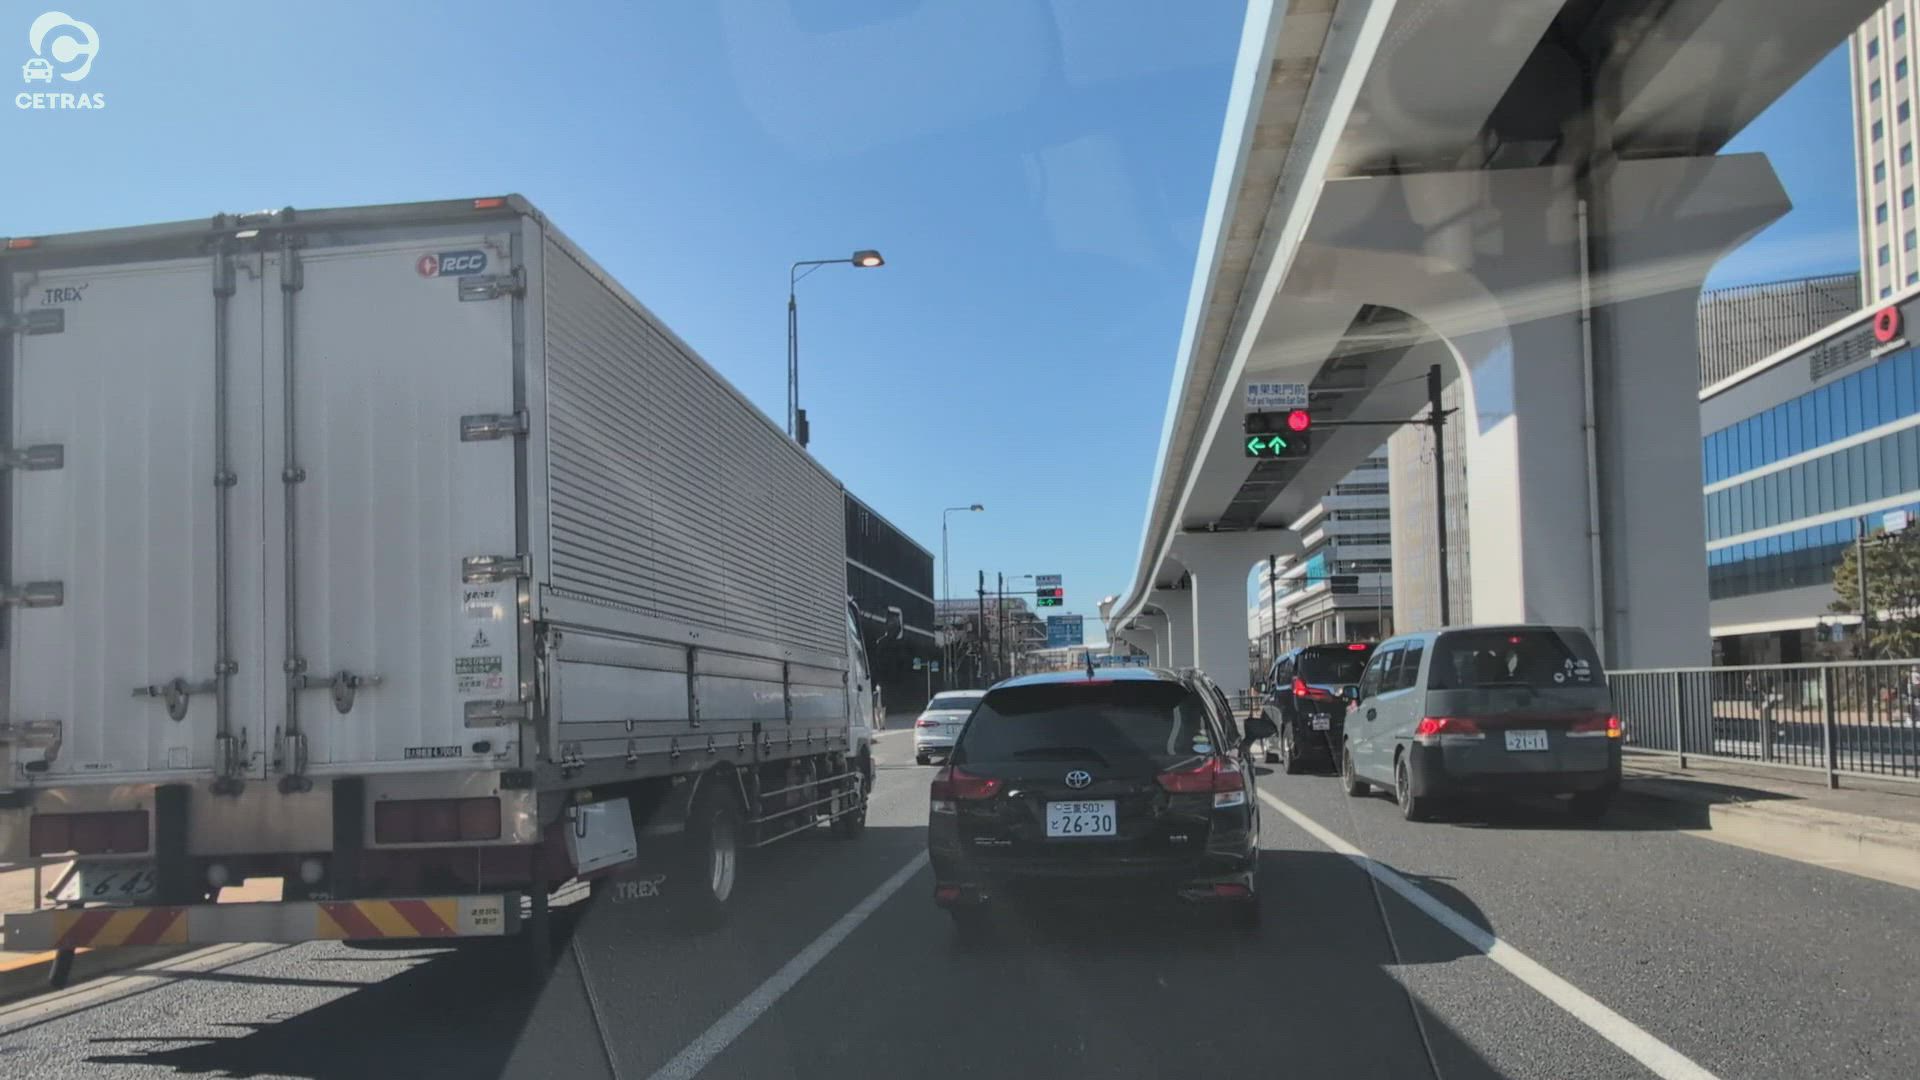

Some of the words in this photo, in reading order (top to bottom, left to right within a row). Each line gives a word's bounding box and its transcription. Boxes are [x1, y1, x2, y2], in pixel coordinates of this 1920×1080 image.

[442, 255, 483, 272] RCC
[45, 286, 83, 303] TREX
[1062, 815, 1112, 834] 26-30
[616, 878, 663, 899] TREX
